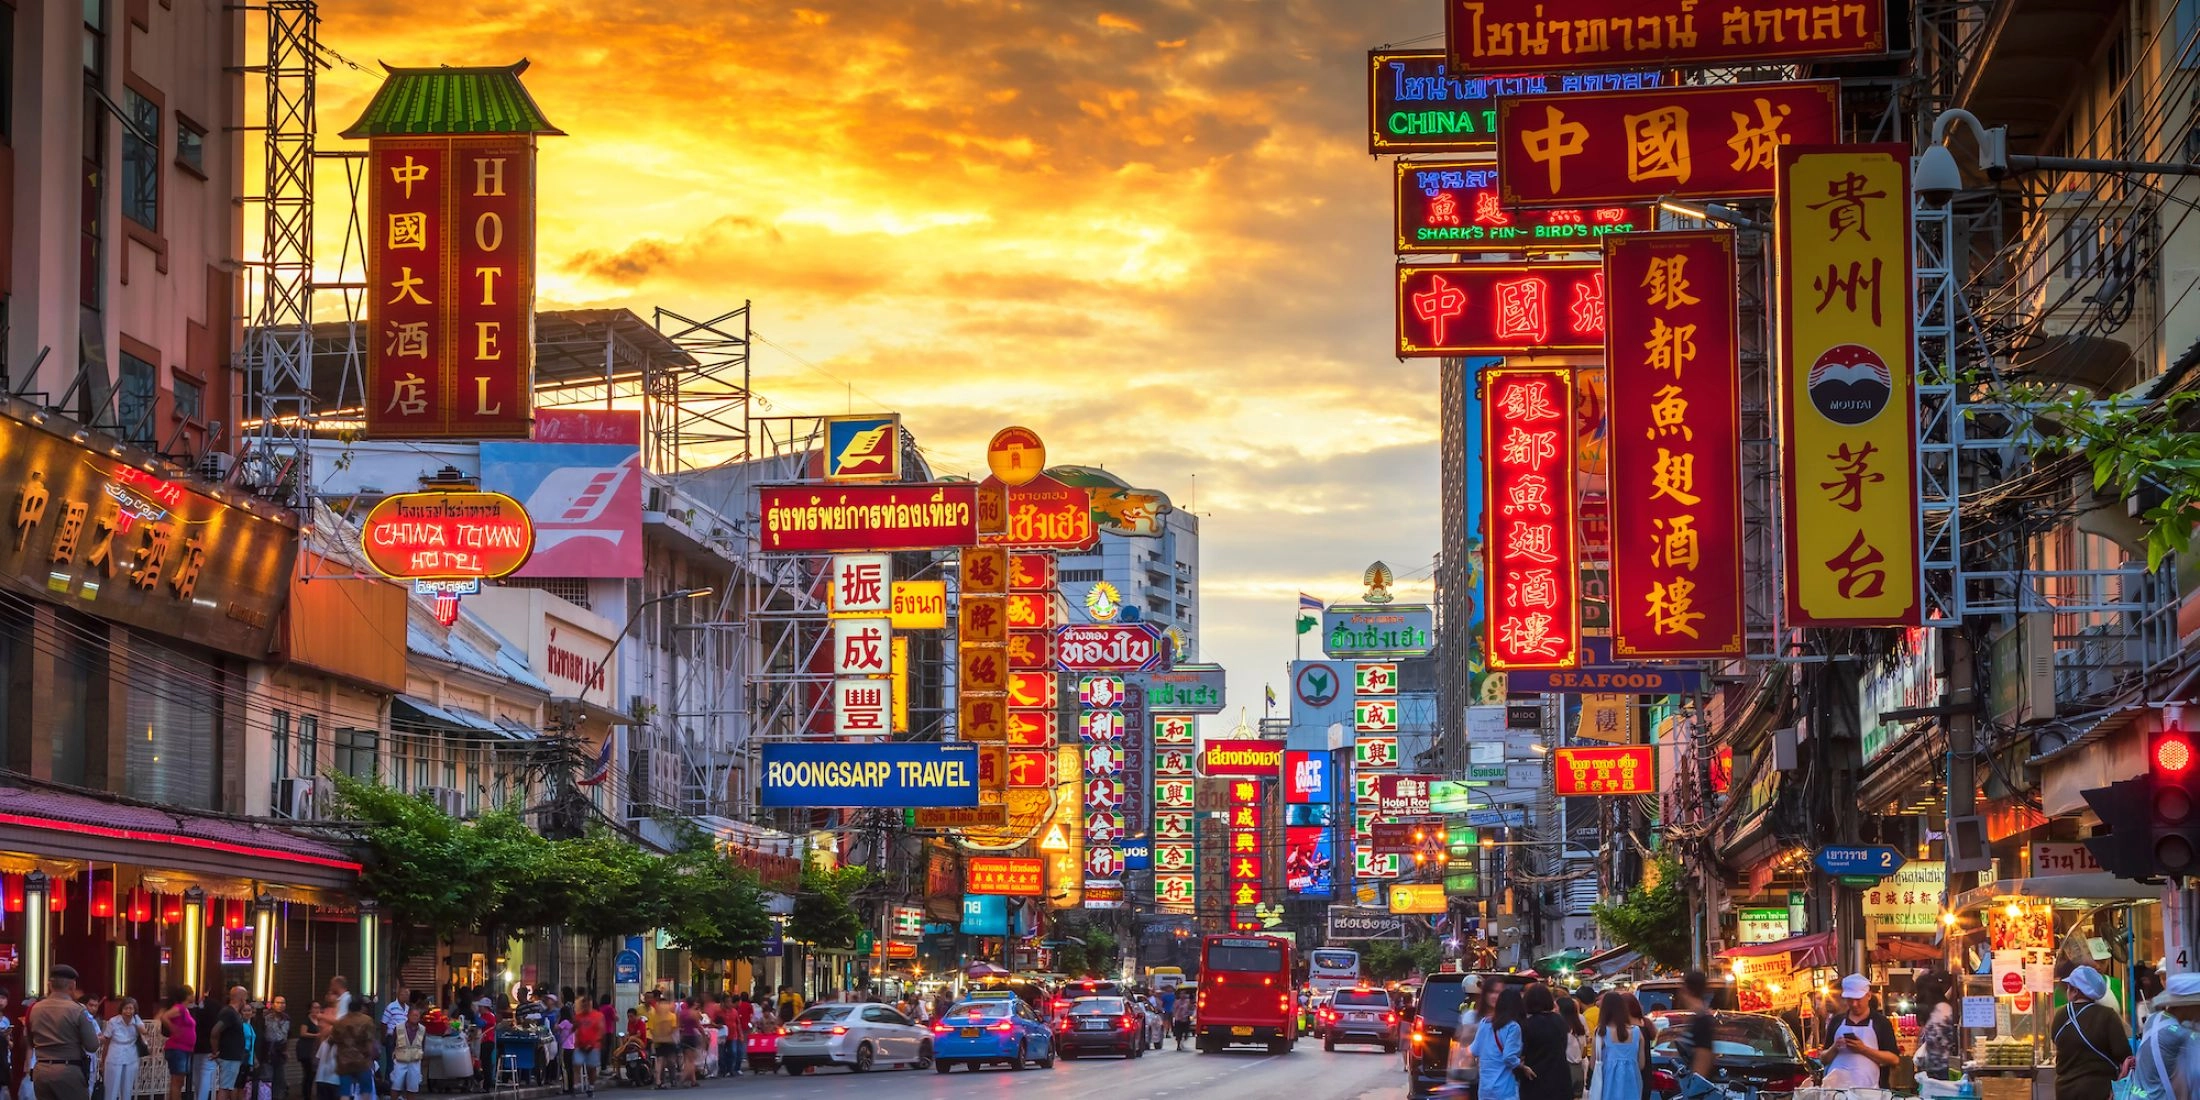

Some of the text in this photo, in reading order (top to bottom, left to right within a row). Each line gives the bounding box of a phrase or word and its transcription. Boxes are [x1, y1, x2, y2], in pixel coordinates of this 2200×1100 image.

[1389, 111, 1474, 134] CHINA
[1520, 98, 1792, 196] 中國城
[1417, 226, 1484, 239] SHARK'S
[1535, 224, 1587, 238] BIRD'S
[384, 155, 432, 417] 中國大酒店
[472, 157, 507, 416] HOTEL
[1829, 400, 1872, 411] MOUTAI
[1640, 253, 1706, 640] 銀都魚翅酒樓
[1497, 382, 1564, 658] 銀都魚翅酒樓
[374, 523, 521, 548] CHINA TOWN
[411, 551, 483, 571] HOTEL
[842, 563, 883, 730] 振成豐
[1549, 673, 1662, 688] SEAFOOD
[768, 761, 970, 787] ROONGSARP TRAVEL
[1296, 760, 1321, 775] APP
[1296, 774, 1321, 789] WAR
[1382, 798, 1408, 807] Hotel
[1057, 785, 1075, 898] 北京仁堂
[1123, 847, 1149, 857] UOB
[1236, 783, 1256, 929] 聯成興大金
[1826, 850, 1892, 867] เยาวราช 2
[2176, 950, 2188, 968] 4
